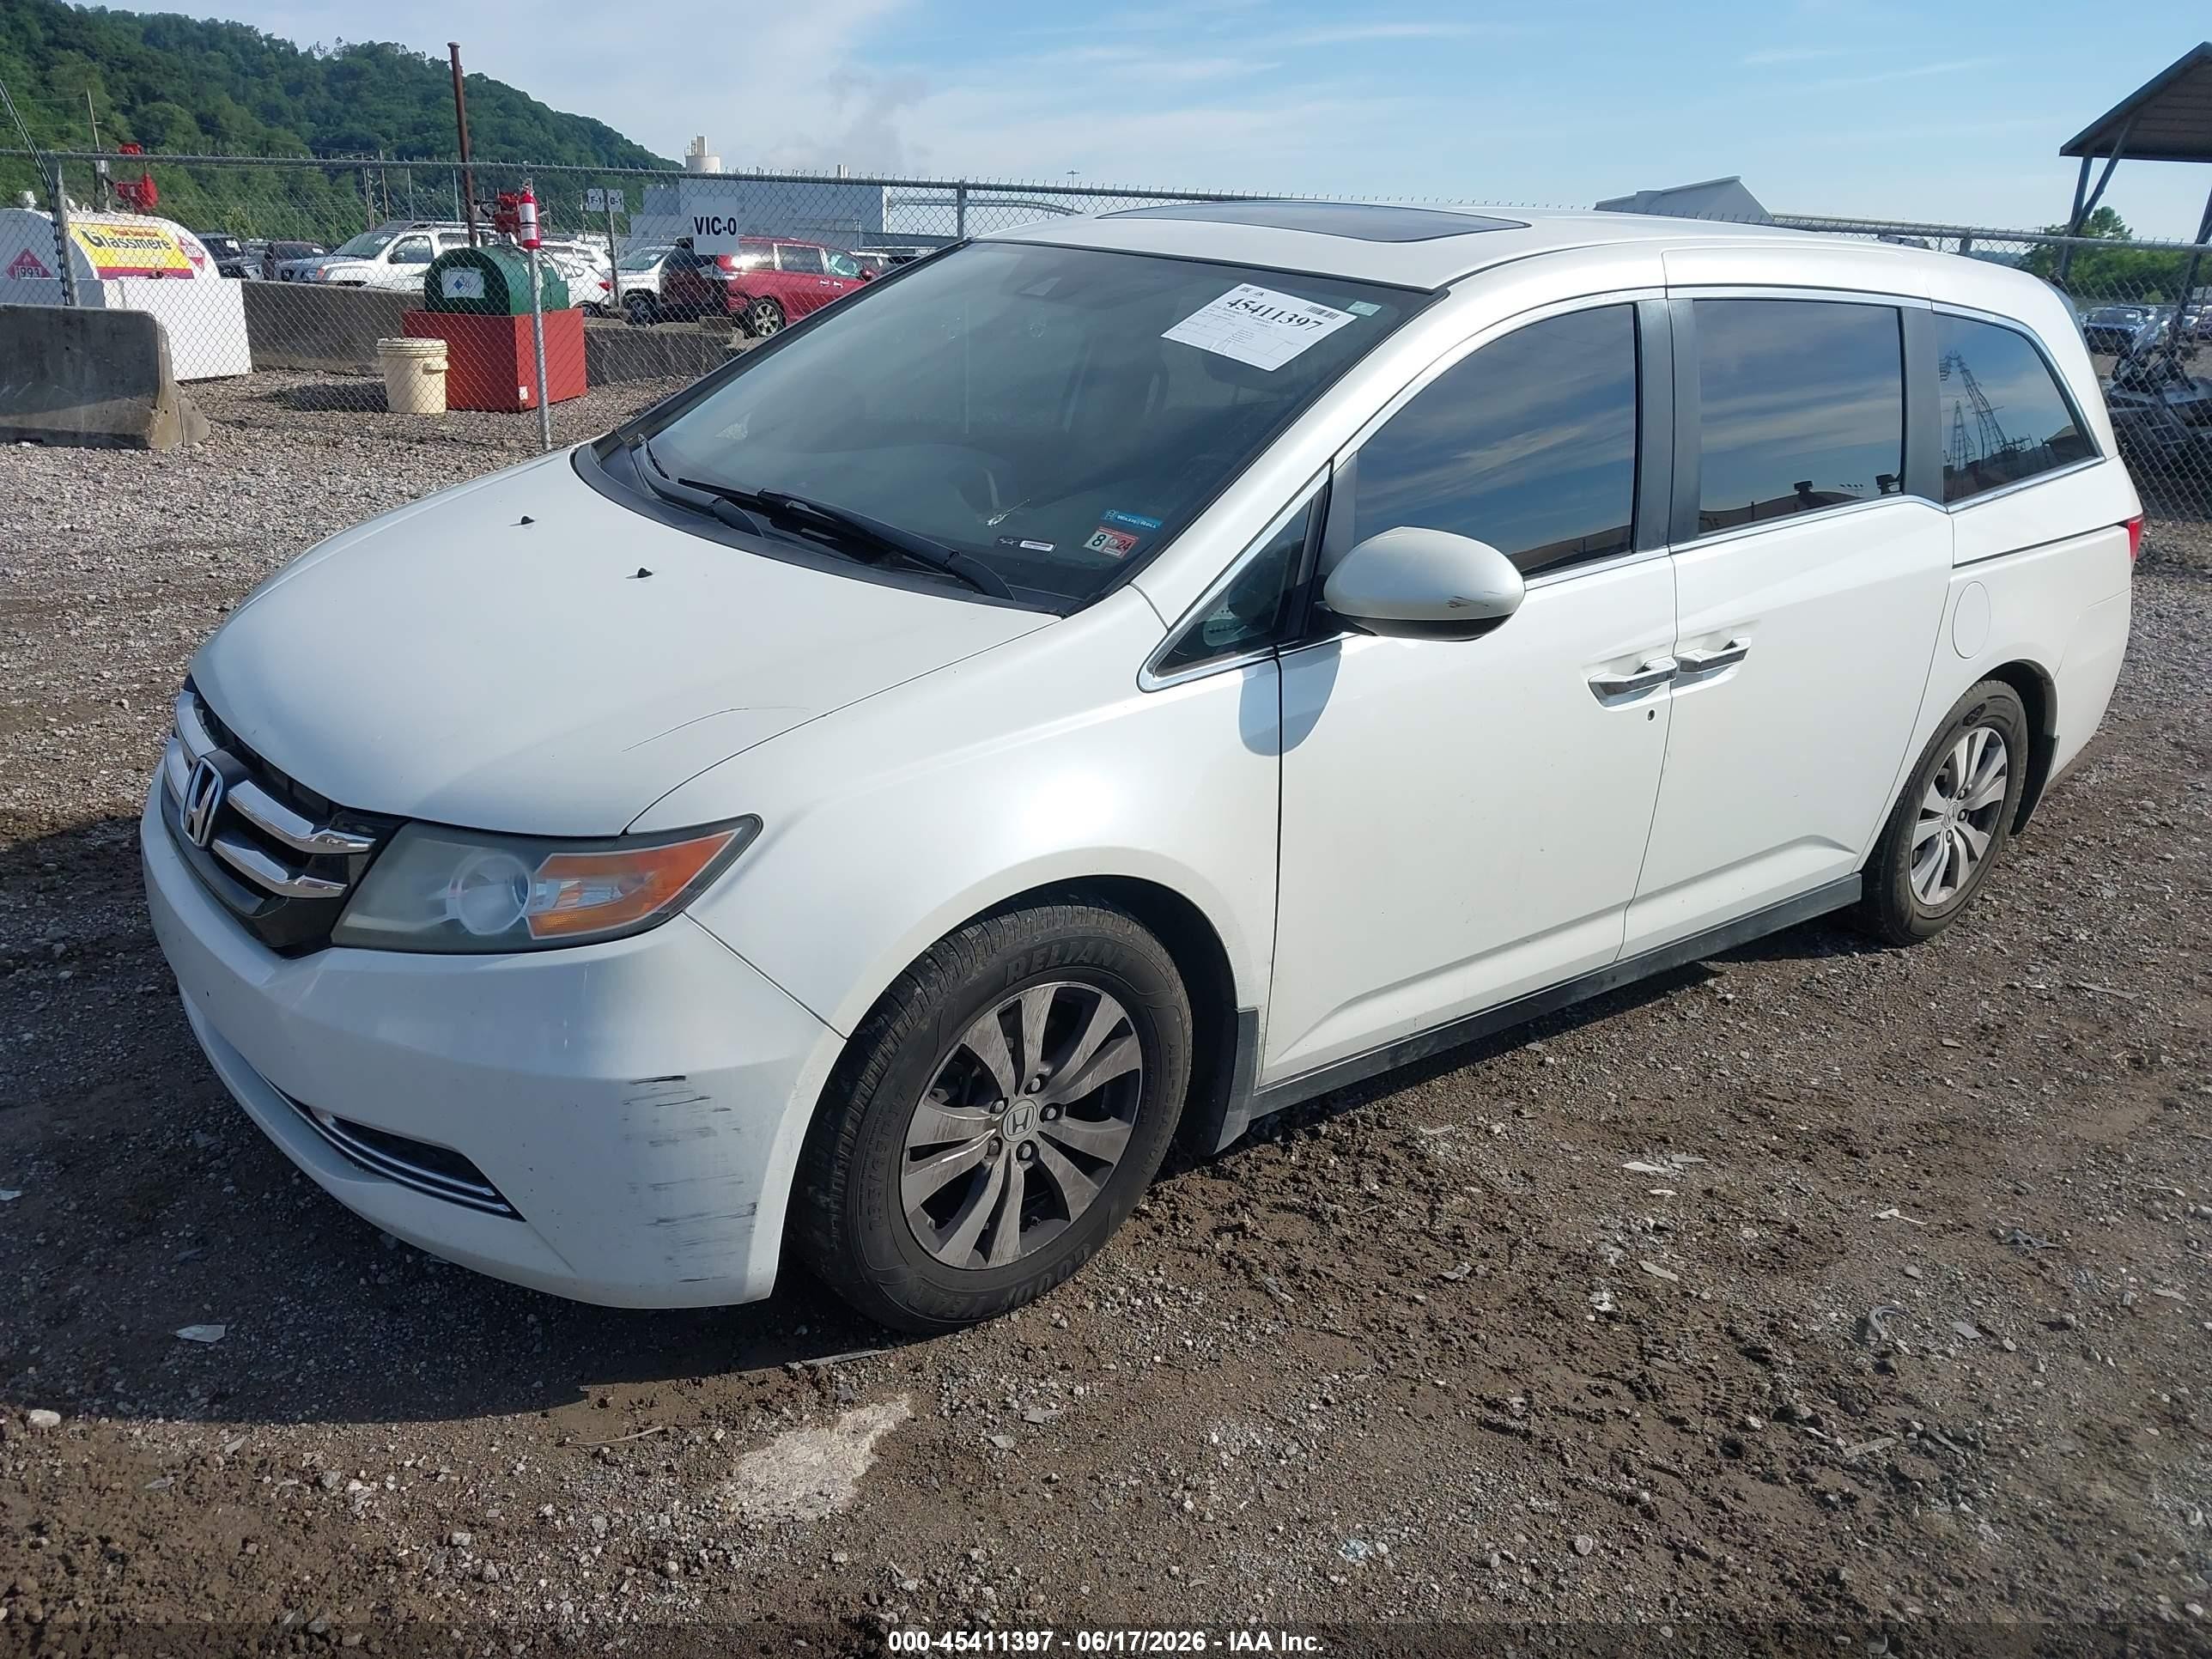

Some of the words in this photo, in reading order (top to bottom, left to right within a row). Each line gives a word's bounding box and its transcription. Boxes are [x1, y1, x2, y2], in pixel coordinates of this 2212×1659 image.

[693, 216, 738, 236] VIC-0
[80, 227, 173, 251] Glassmere
[1226, 297, 1326, 331] 45411397
[1091, 534, 1107, 547] 8
